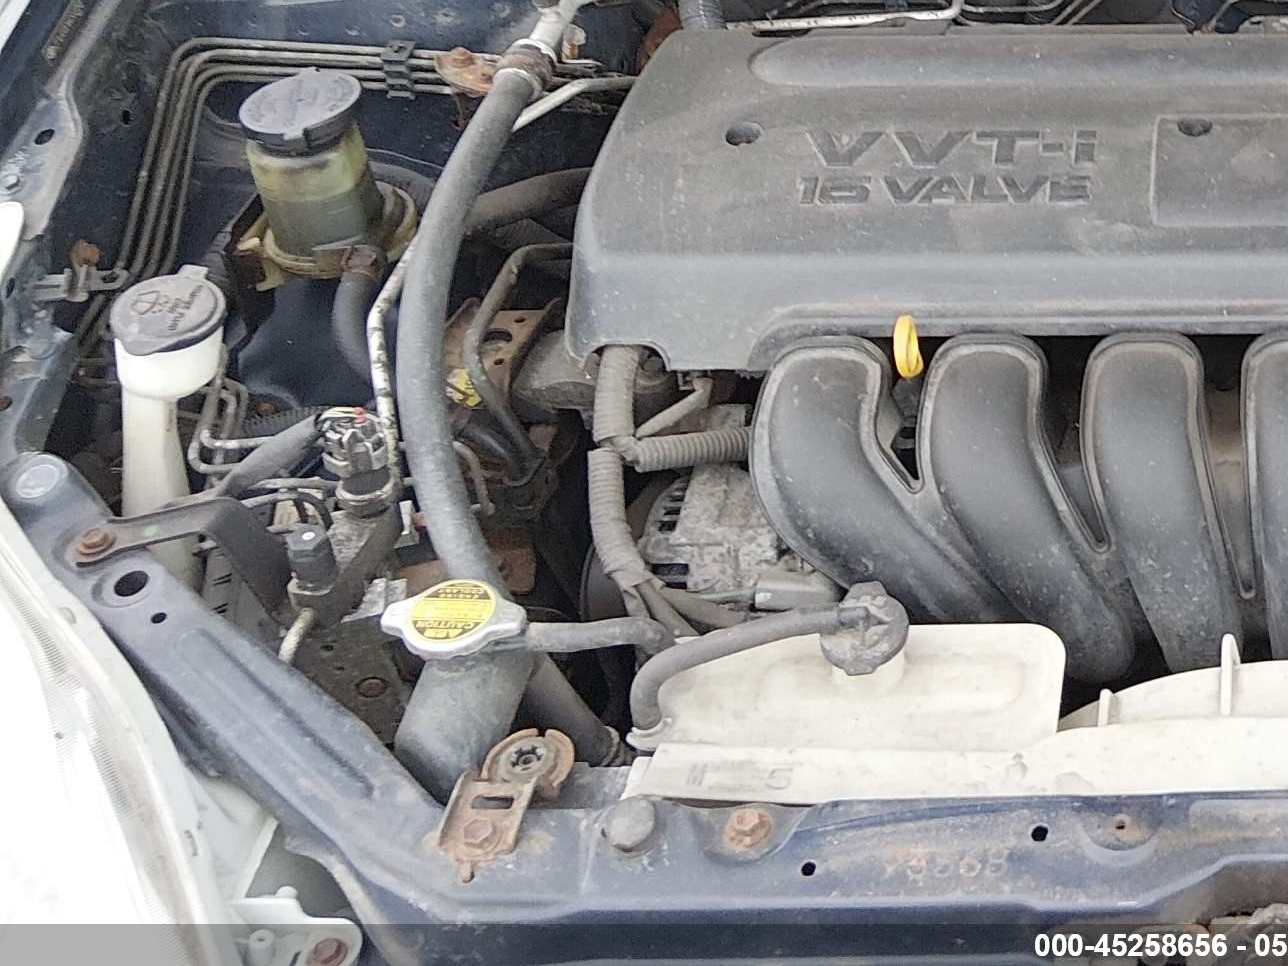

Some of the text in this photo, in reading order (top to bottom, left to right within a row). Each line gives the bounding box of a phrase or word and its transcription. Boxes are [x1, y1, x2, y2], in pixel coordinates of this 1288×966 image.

[804, 130, 1097, 168] VVT-i
[797, 174, 1092, 206] 16 VALVE
[415, 620, 476, 630] CAUTION
